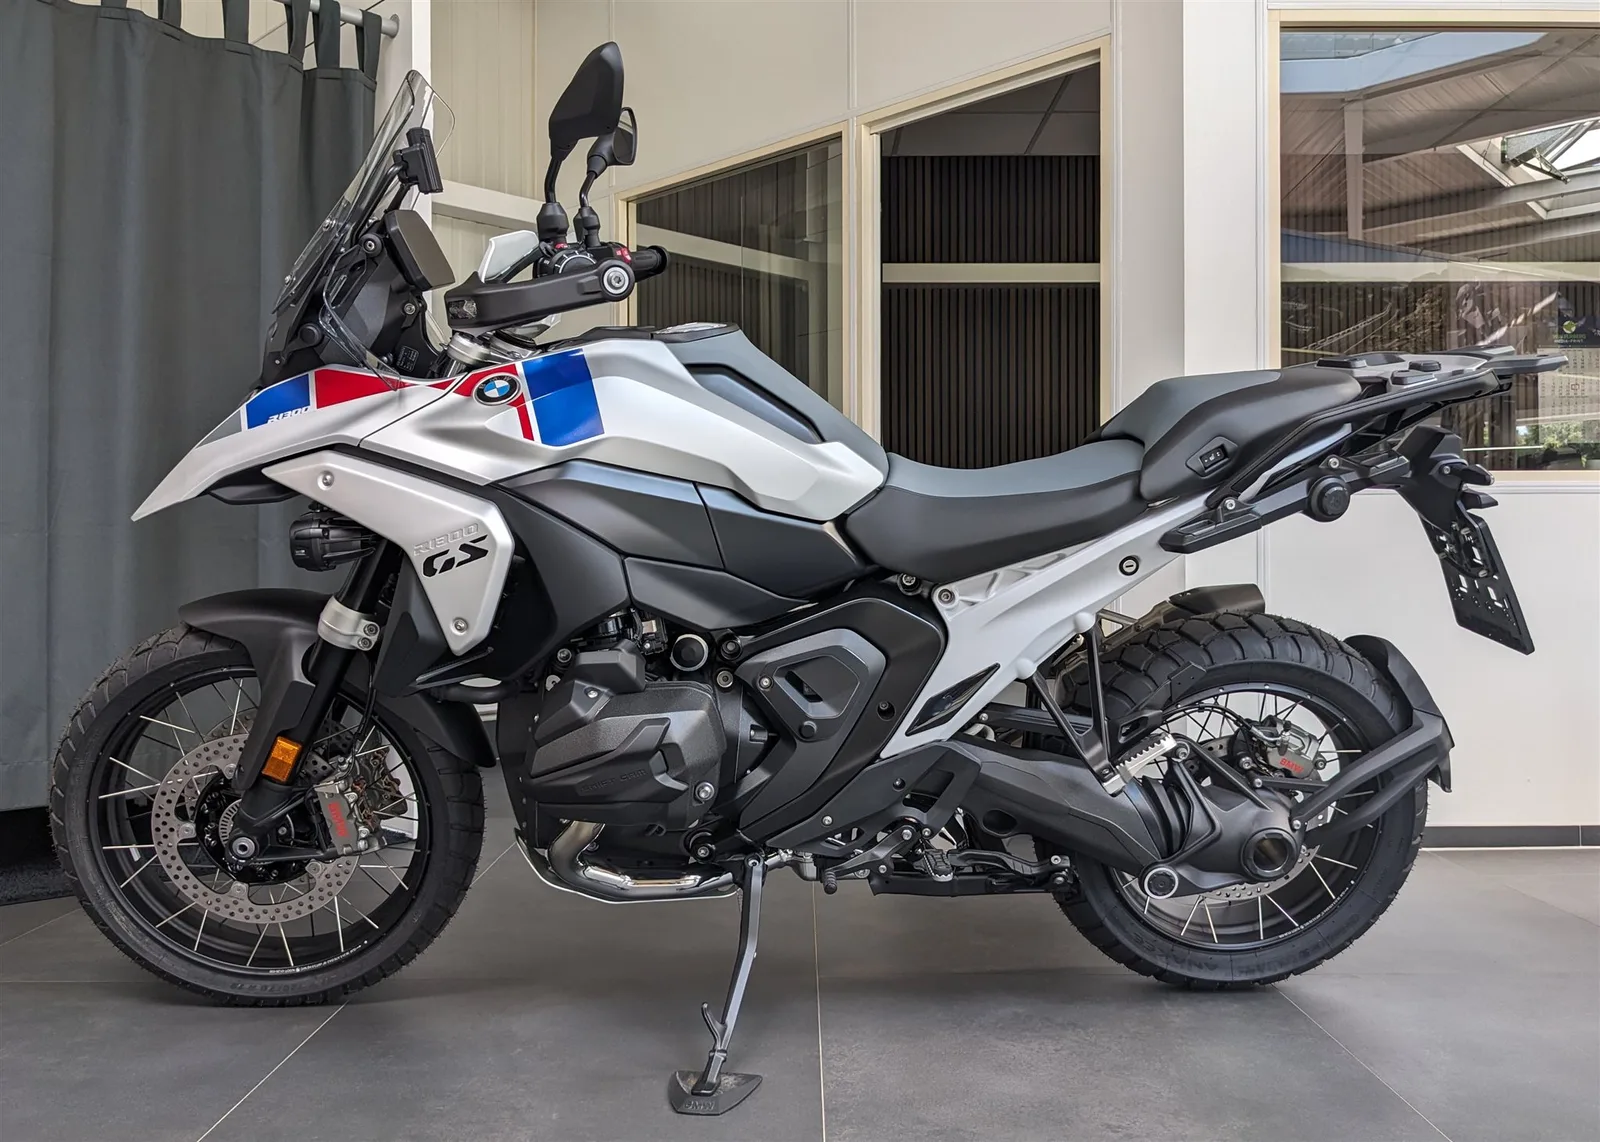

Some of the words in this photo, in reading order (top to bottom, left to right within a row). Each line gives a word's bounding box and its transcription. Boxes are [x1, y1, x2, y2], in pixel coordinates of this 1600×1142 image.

[413, 522, 479, 556] R1300
[422, 534, 489, 578] GS
[1279, 757, 1303, 773] BMW
